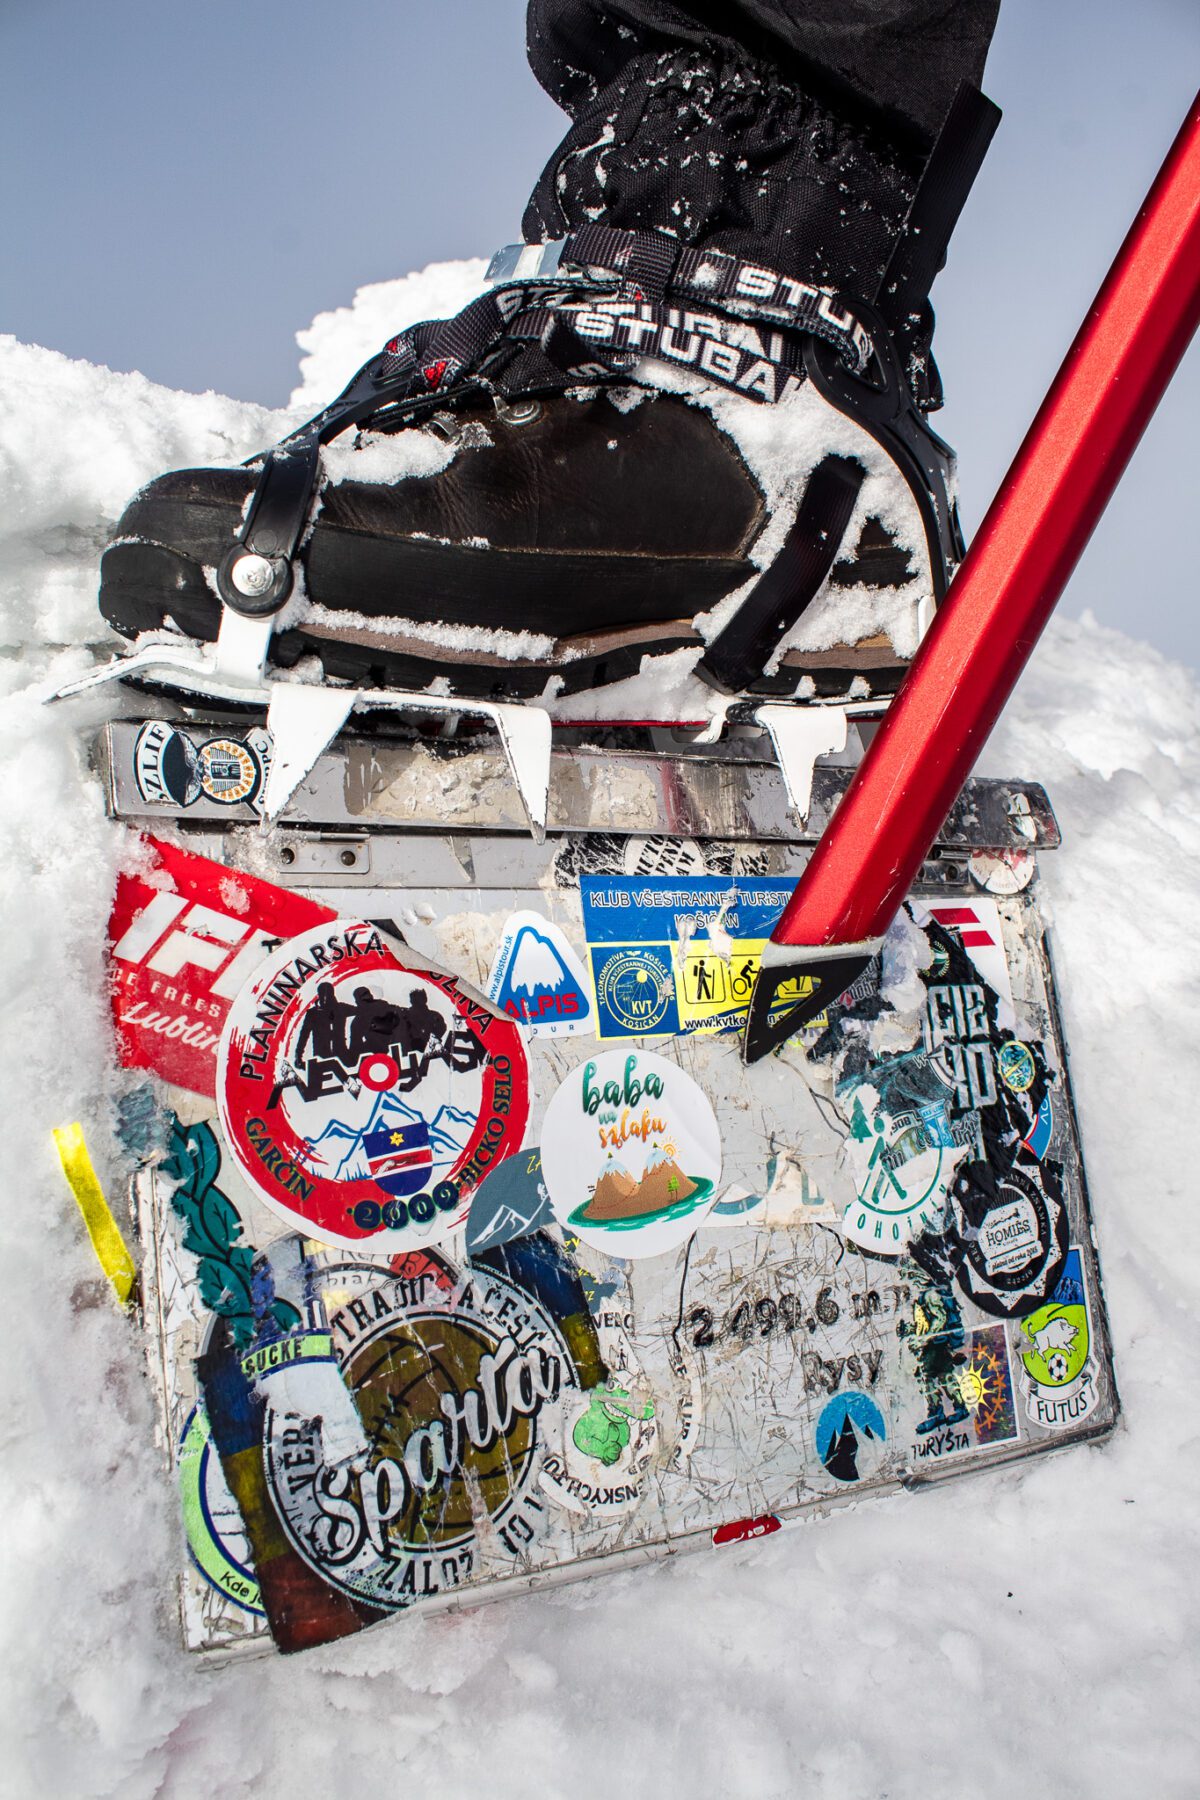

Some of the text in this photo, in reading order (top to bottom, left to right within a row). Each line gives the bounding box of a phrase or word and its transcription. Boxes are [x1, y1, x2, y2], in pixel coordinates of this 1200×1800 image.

[590, 891, 630, 908] KLUB
[240, 929, 386, 1081] PLANINARSKA
[503, 992, 579, 1019] ALPIS
[631, 999, 652, 1015] KVT
[582, 1054, 665, 1116] baba
[245, 1117, 316, 1200] GARČIN
[491, 1053, 512, 1115] SELO
[598, 1107, 667, 1149] szlaku
[1036, 1390, 1089, 1424] FUTUS
[306, 1335, 560, 1566] Sparta
[219, 1571, 250, 1598] Kde
